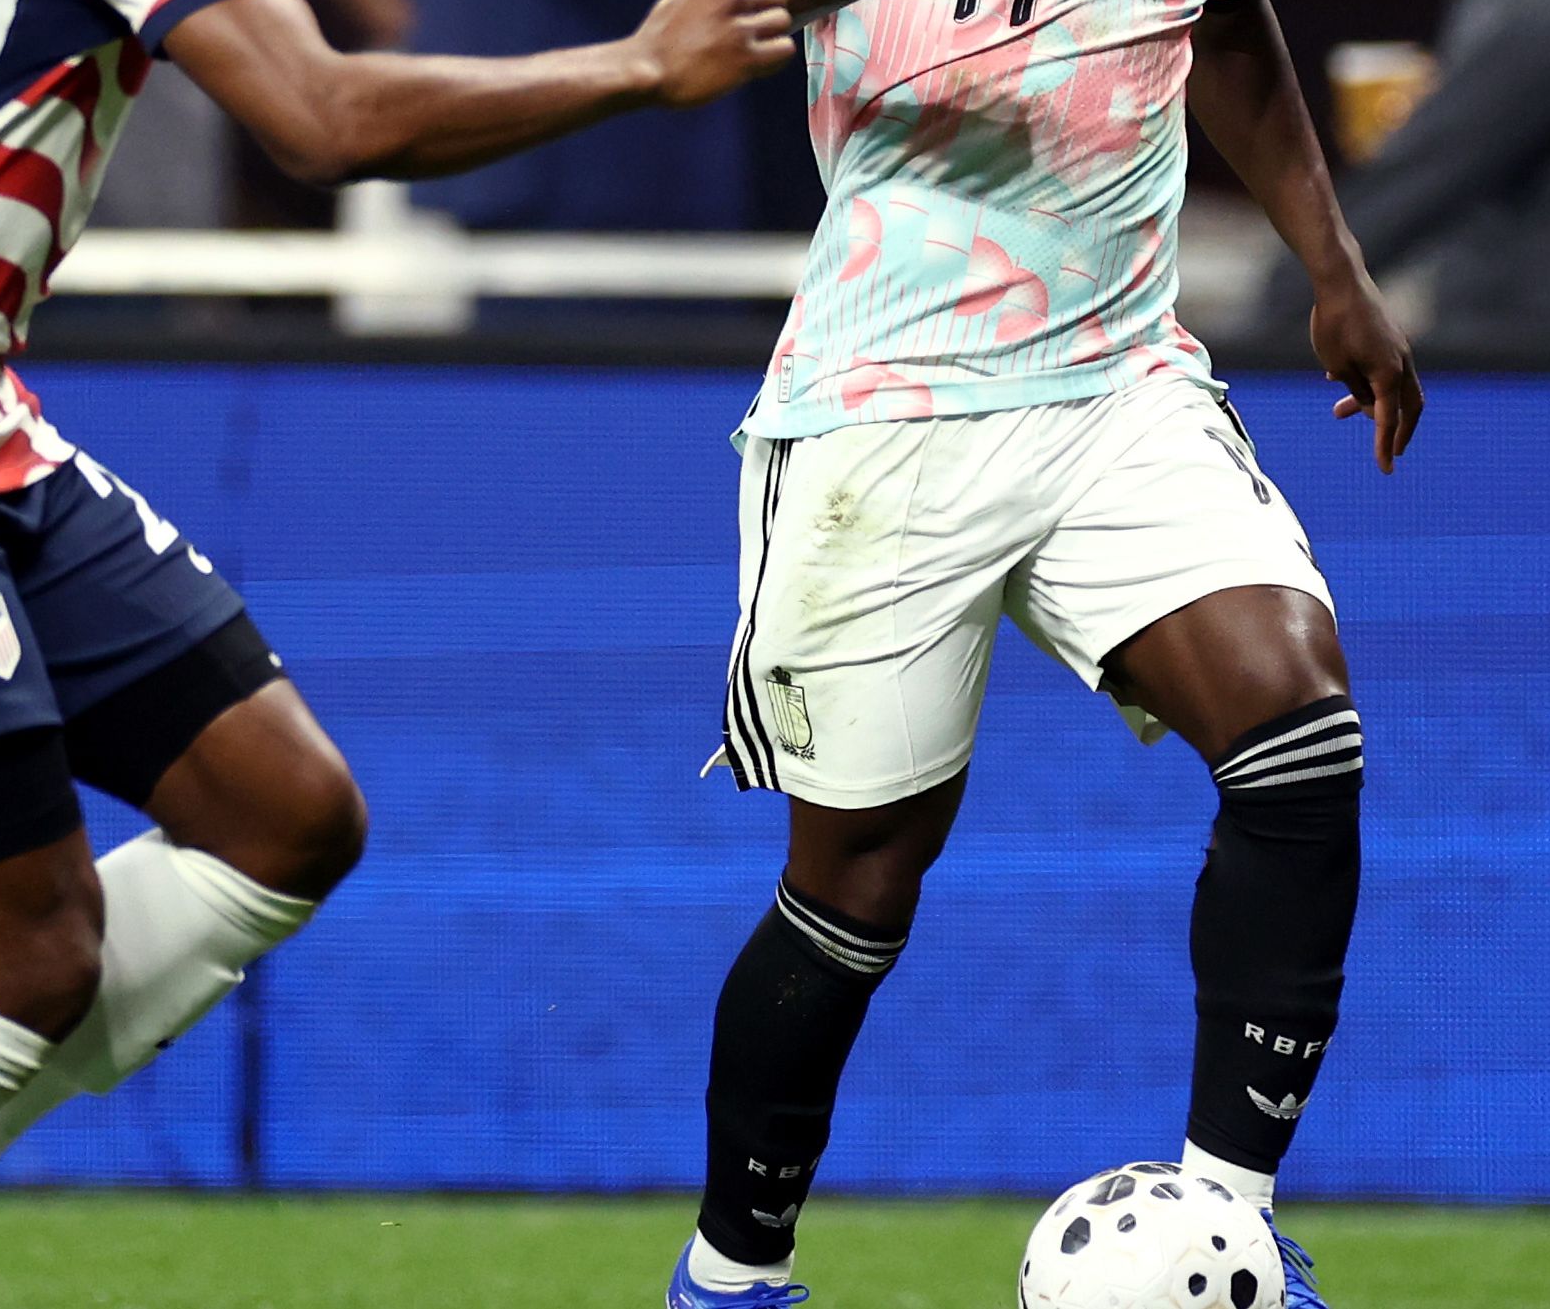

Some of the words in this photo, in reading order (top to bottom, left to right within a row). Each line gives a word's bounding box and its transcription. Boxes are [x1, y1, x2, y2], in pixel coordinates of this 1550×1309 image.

[74, 449, 214, 575] 2
[1244, 1021, 1333, 1059] RBF
[747, 1156, 818, 1179] RB
